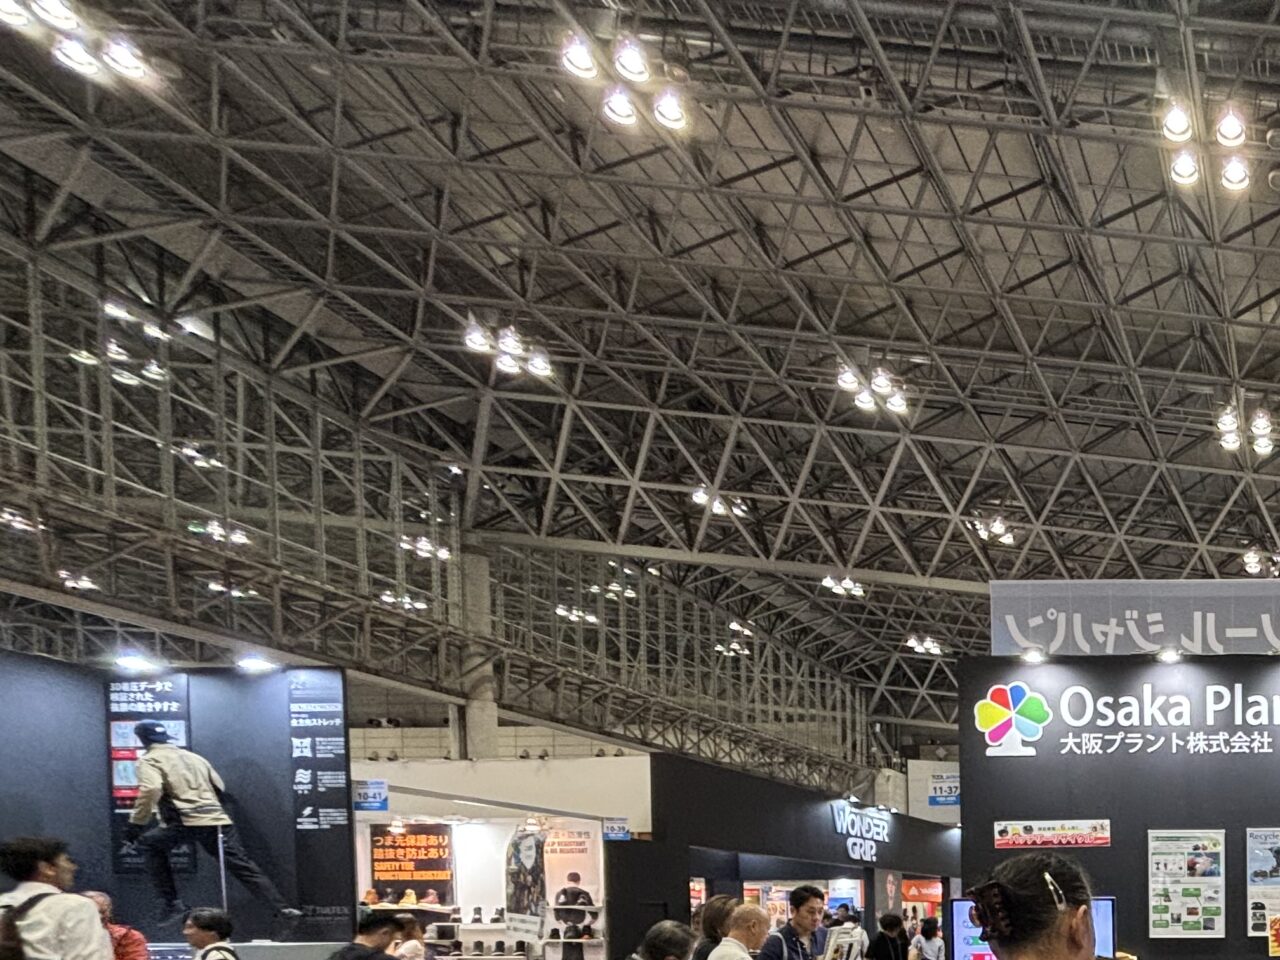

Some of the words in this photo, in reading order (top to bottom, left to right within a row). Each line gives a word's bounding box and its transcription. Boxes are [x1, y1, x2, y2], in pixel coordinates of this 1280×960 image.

[1059, 684, 1191, 727] Osaka
[1059, 731, 1274, 755] 大阪プラント株式会社
[357, 792, 382, 800] 10-41
[932, 786, 959, 795] 11-37
[831, 803, 890, 843] WONDER
[1249, 832, 1280, 841] Recycle
